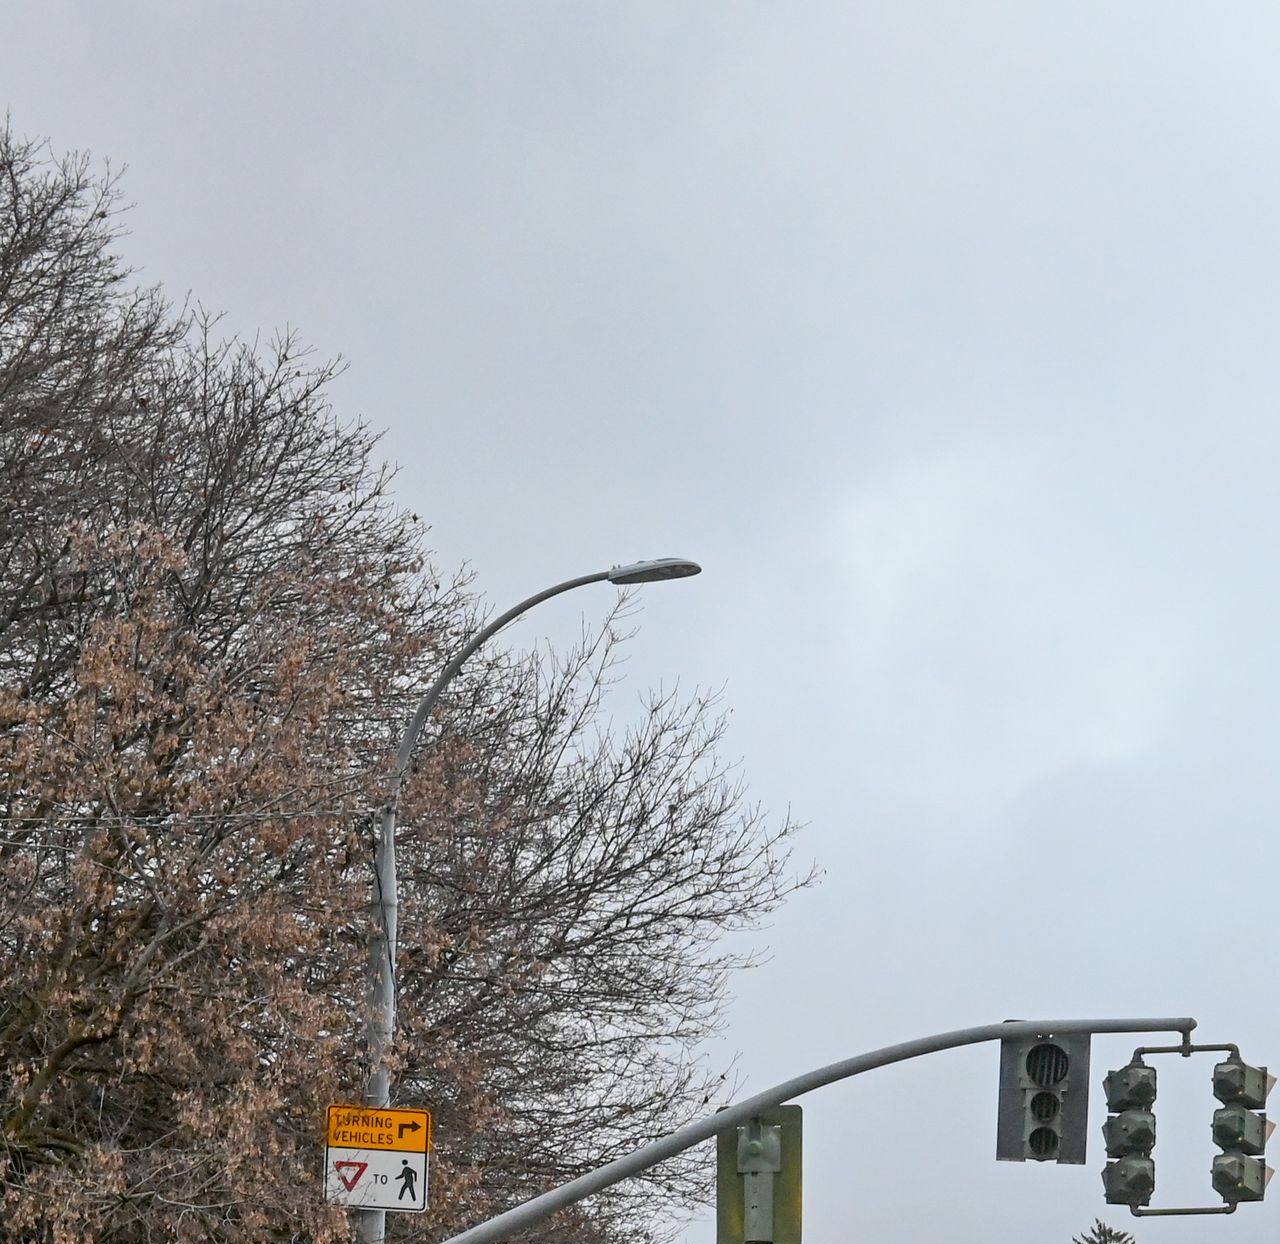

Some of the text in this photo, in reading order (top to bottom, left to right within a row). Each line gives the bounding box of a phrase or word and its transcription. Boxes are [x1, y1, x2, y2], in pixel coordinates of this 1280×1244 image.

[335, 1114, 393, 1128] TURNING
[334, 1130, 394, 1145] VEHICLES
[373, 1174, 388, 1185] TO
